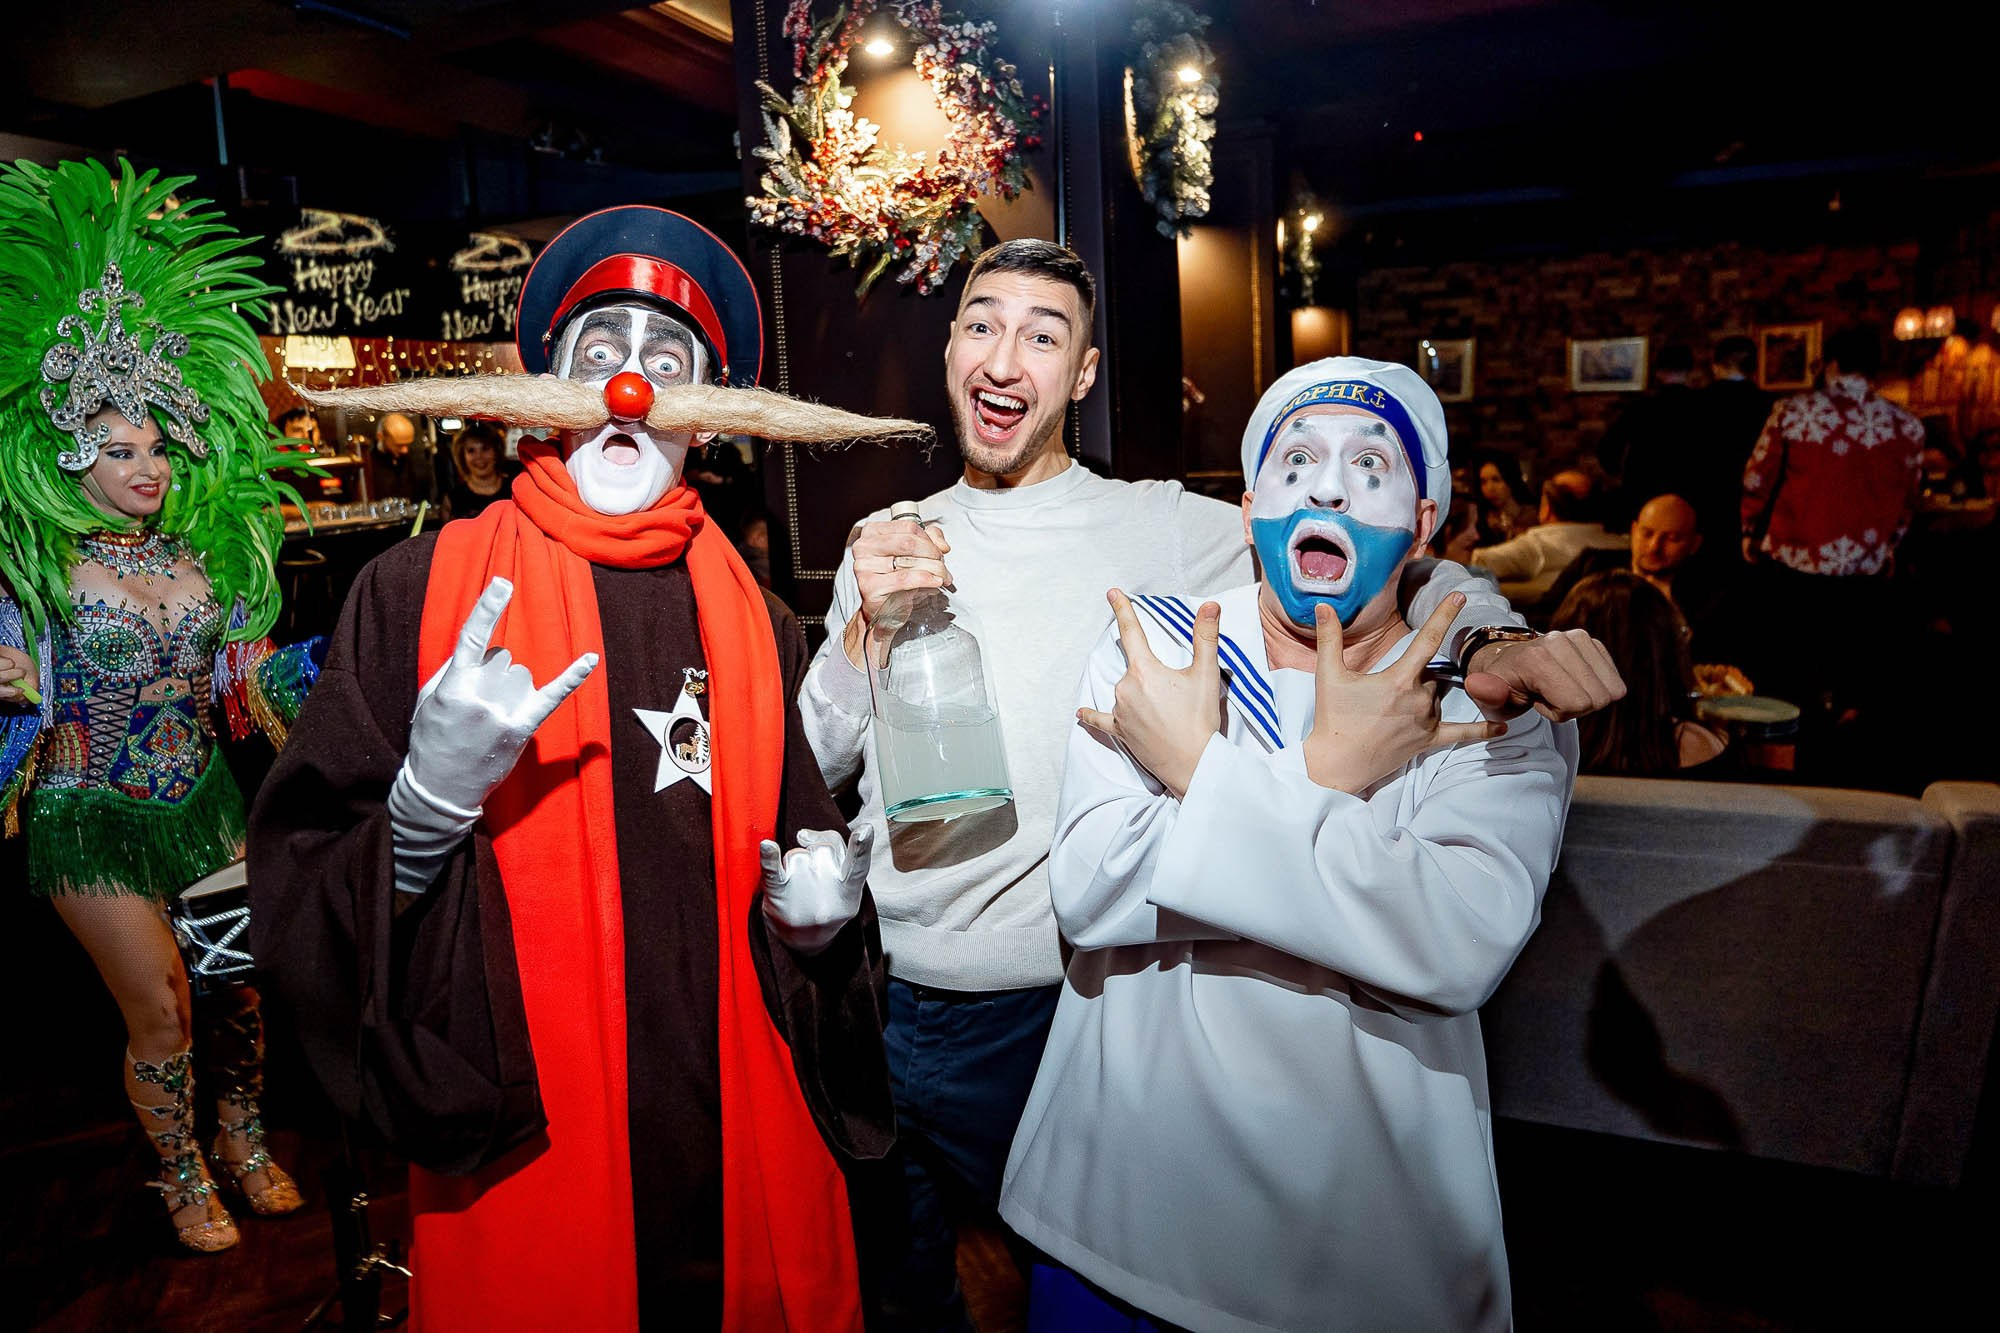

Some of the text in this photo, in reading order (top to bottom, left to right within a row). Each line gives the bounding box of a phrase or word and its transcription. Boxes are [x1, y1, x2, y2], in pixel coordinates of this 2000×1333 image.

[293, 258, 373, 297] Happy
[461, 275, 521, 309] Happy
[270, 288, 410, 335] New Year
[442, 310, 495, 341] New
